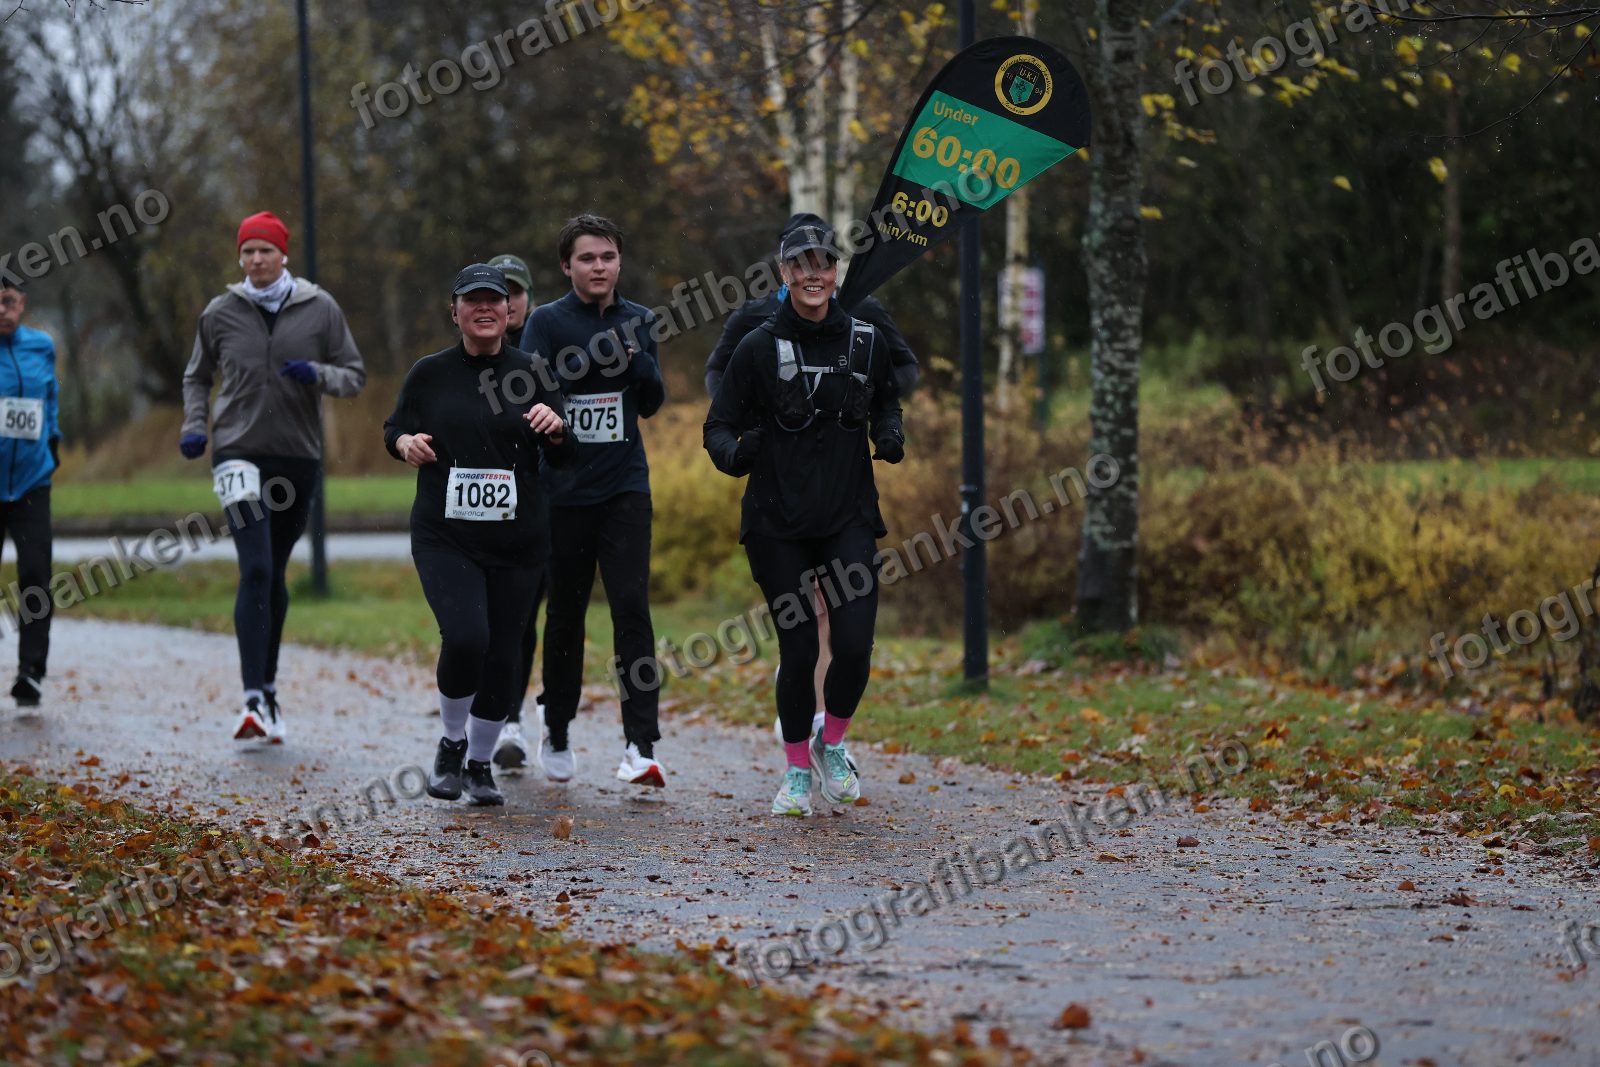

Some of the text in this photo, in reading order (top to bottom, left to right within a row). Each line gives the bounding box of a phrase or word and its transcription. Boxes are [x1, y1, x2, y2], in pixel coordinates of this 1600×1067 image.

[933, 100, 980, 127] Under
[912, 126, 1021, 189] 60:00
[891, 191, 949, 228] 6:00
[878, 221, 928, 248] min/km
[5, 409, 37, 430] 506
[567, 406, 617, 431] 1075
[218, 471, 245, 496] 371
[455, 472, 511, 481] NORGESTESTEN
[455, 482, 511, 508] 1082
